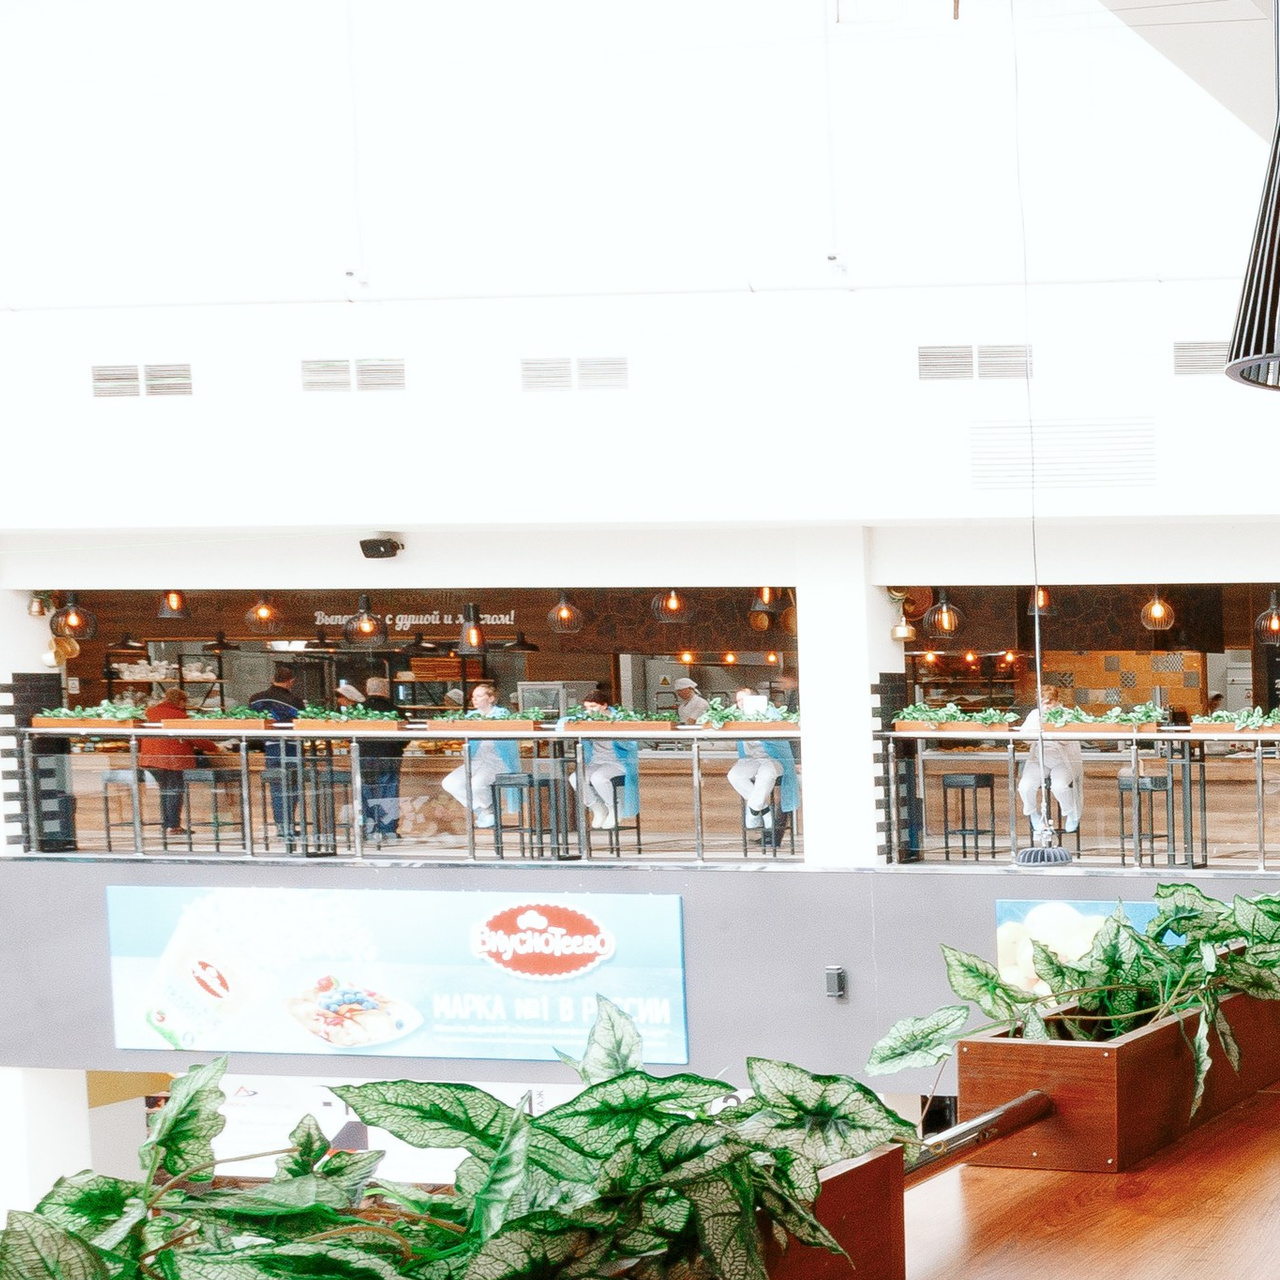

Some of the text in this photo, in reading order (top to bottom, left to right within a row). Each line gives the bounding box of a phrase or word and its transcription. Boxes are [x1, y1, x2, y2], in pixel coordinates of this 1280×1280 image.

[385, 613, 393, 625] с
[395, 611, 441, 631] душой
[443, 613, 454, 625] и
[432, 992, 507, 1020] МАРКА
[559, 995, 576, 1022] В
